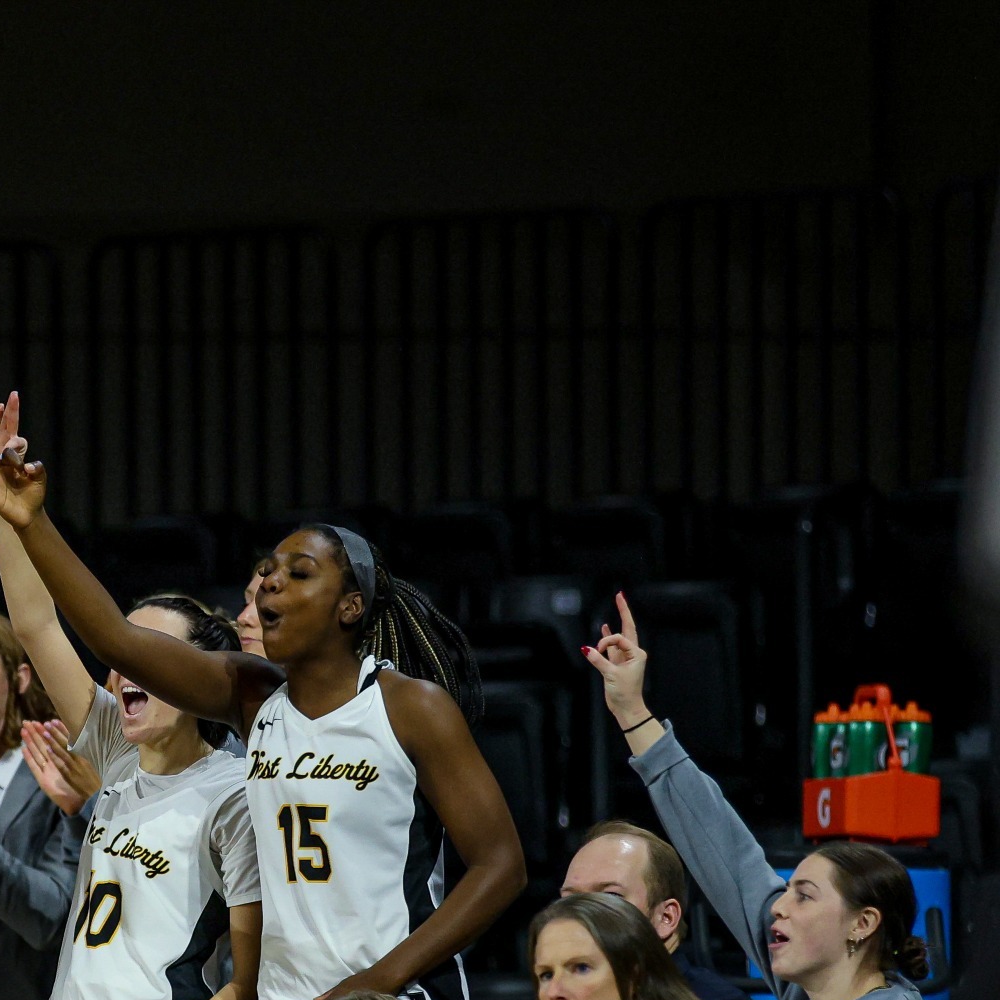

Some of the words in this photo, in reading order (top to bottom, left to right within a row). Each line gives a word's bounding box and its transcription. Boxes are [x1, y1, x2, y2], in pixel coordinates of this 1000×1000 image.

[285, 751, 380, 792] Liberty
[817, 788, 831, 829] G
[103, 828, 171, 879] Liberty
[276, 803, 333, 885] 15
